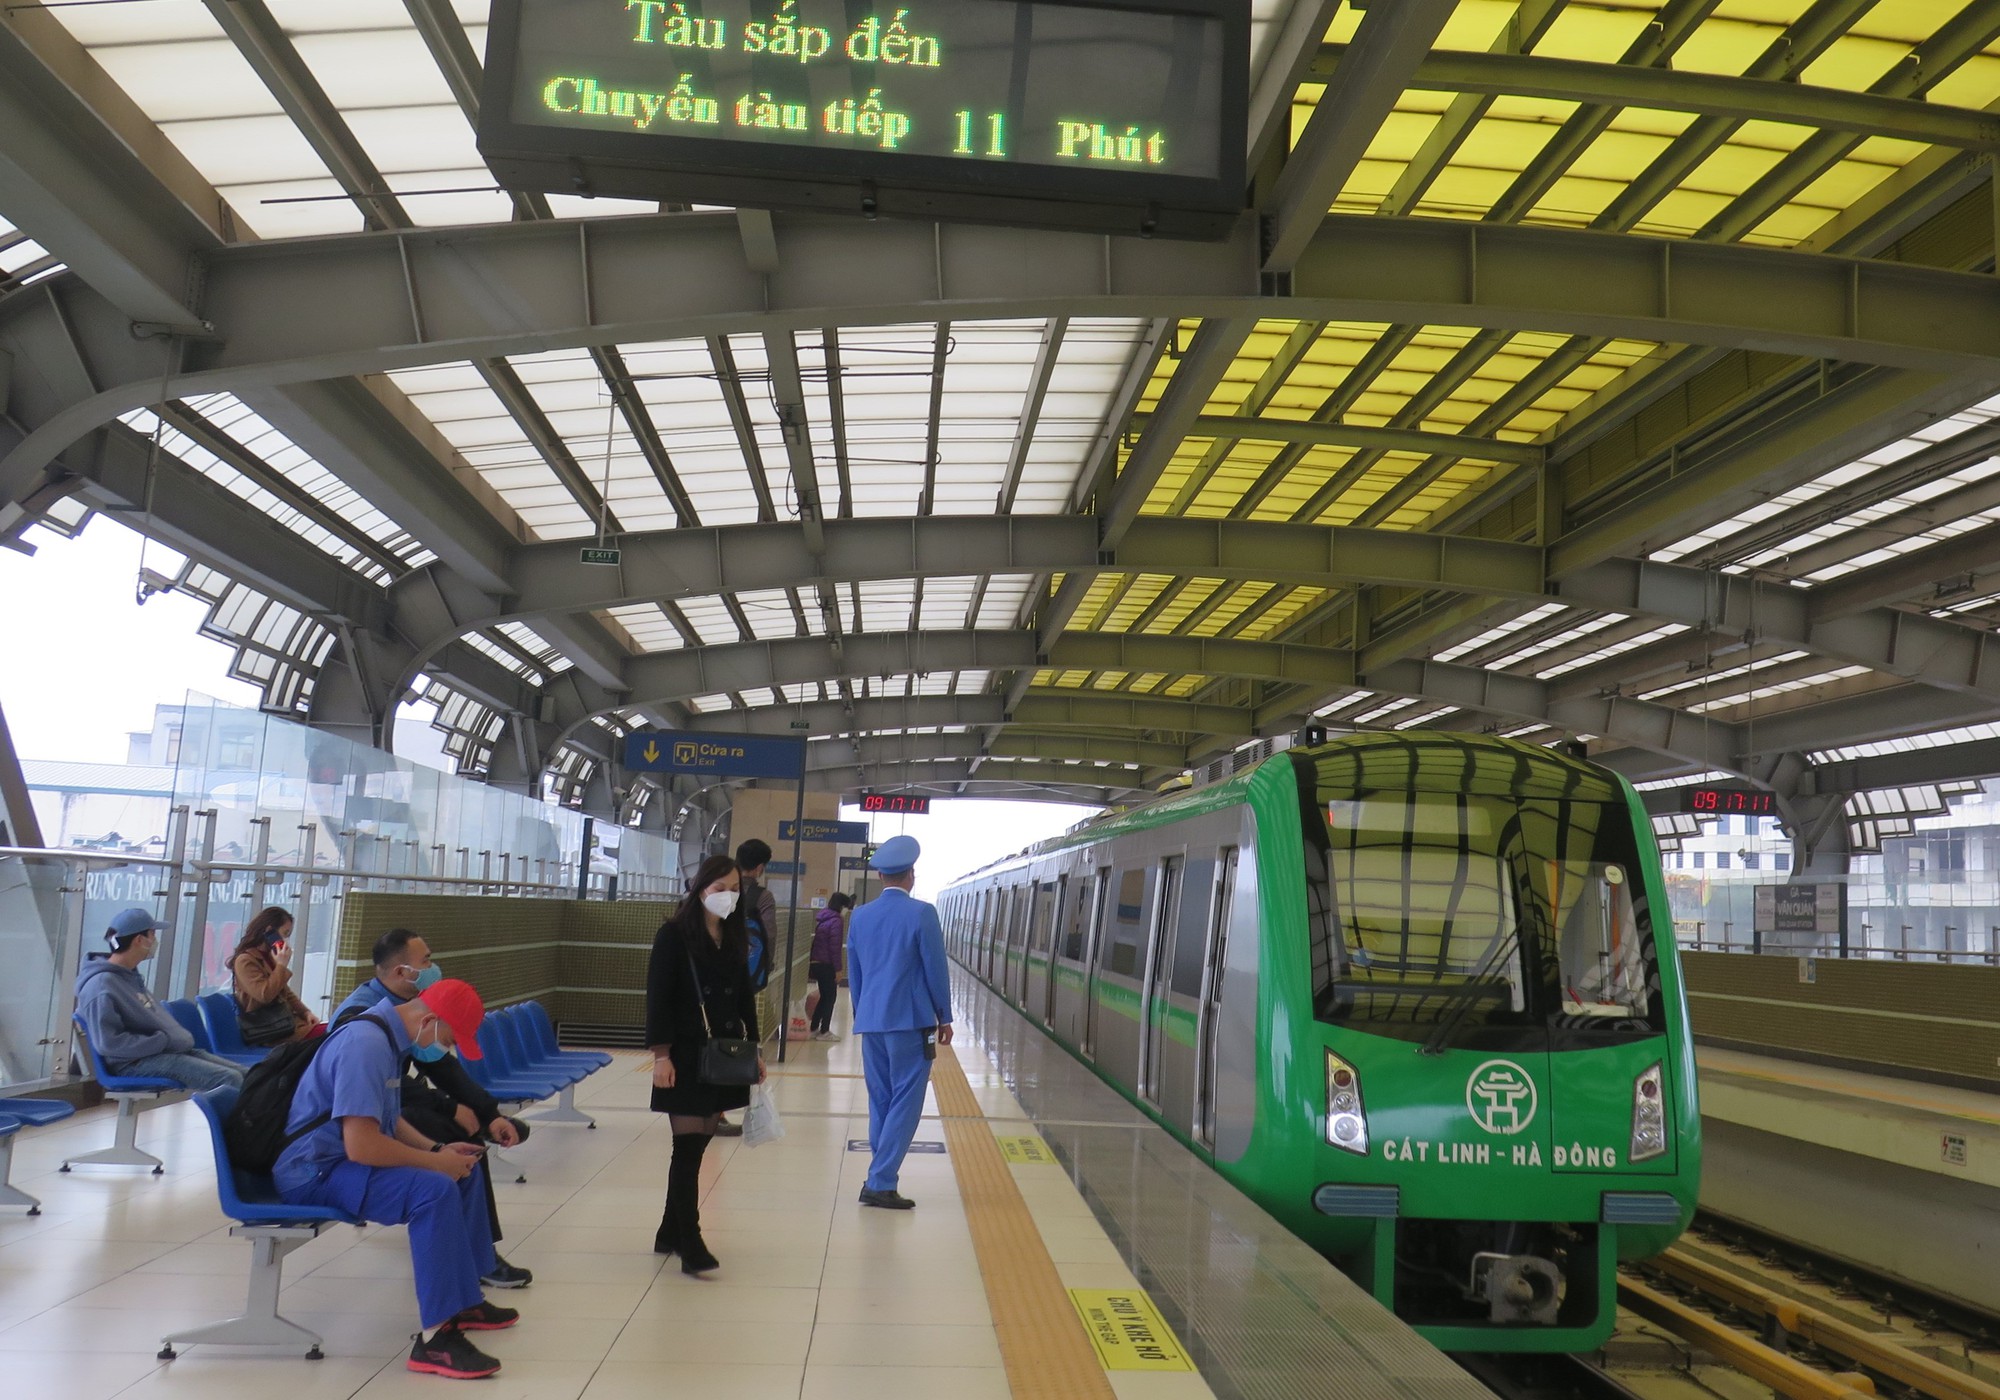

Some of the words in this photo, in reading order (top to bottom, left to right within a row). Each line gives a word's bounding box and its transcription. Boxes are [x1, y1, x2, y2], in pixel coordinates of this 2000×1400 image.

[625, 0, 726, 49] Tàu
[744, 0, 831, 63] sắp
[845, 10, 941, 66] đến
[543, 72, 719, 128] Chuyến
[735, 93, 808, 130] tàu
[823, 88, 911, 148] tiếp
[953, 110, 1006, 157] 11
[1056, 121, 1165, 164] Phút
[588, 550, 614, 558] EXIT
[731, 748, 744, 757] ra
[698, 758, 715, 766] Exit
[865, 796, 925, 811] 09:17:11
[1694, 791, 1770, 811] 09:17:11
[85, 871, 122, 901] RUNG
[1383, 1136, 1429, 1161] CÁT
[1438, 1142, 1490, 1165] LINH
[1512, 1141, 1543, 1167] HÀ
[1554, 1142, 1617, 1168] ĐÔNG
[1107, 1297, 1142, 1314] CHÚ
[1122, 1324, 1156, 1342] KHE
[1134, 1345, 1178, 1361] HỞ
